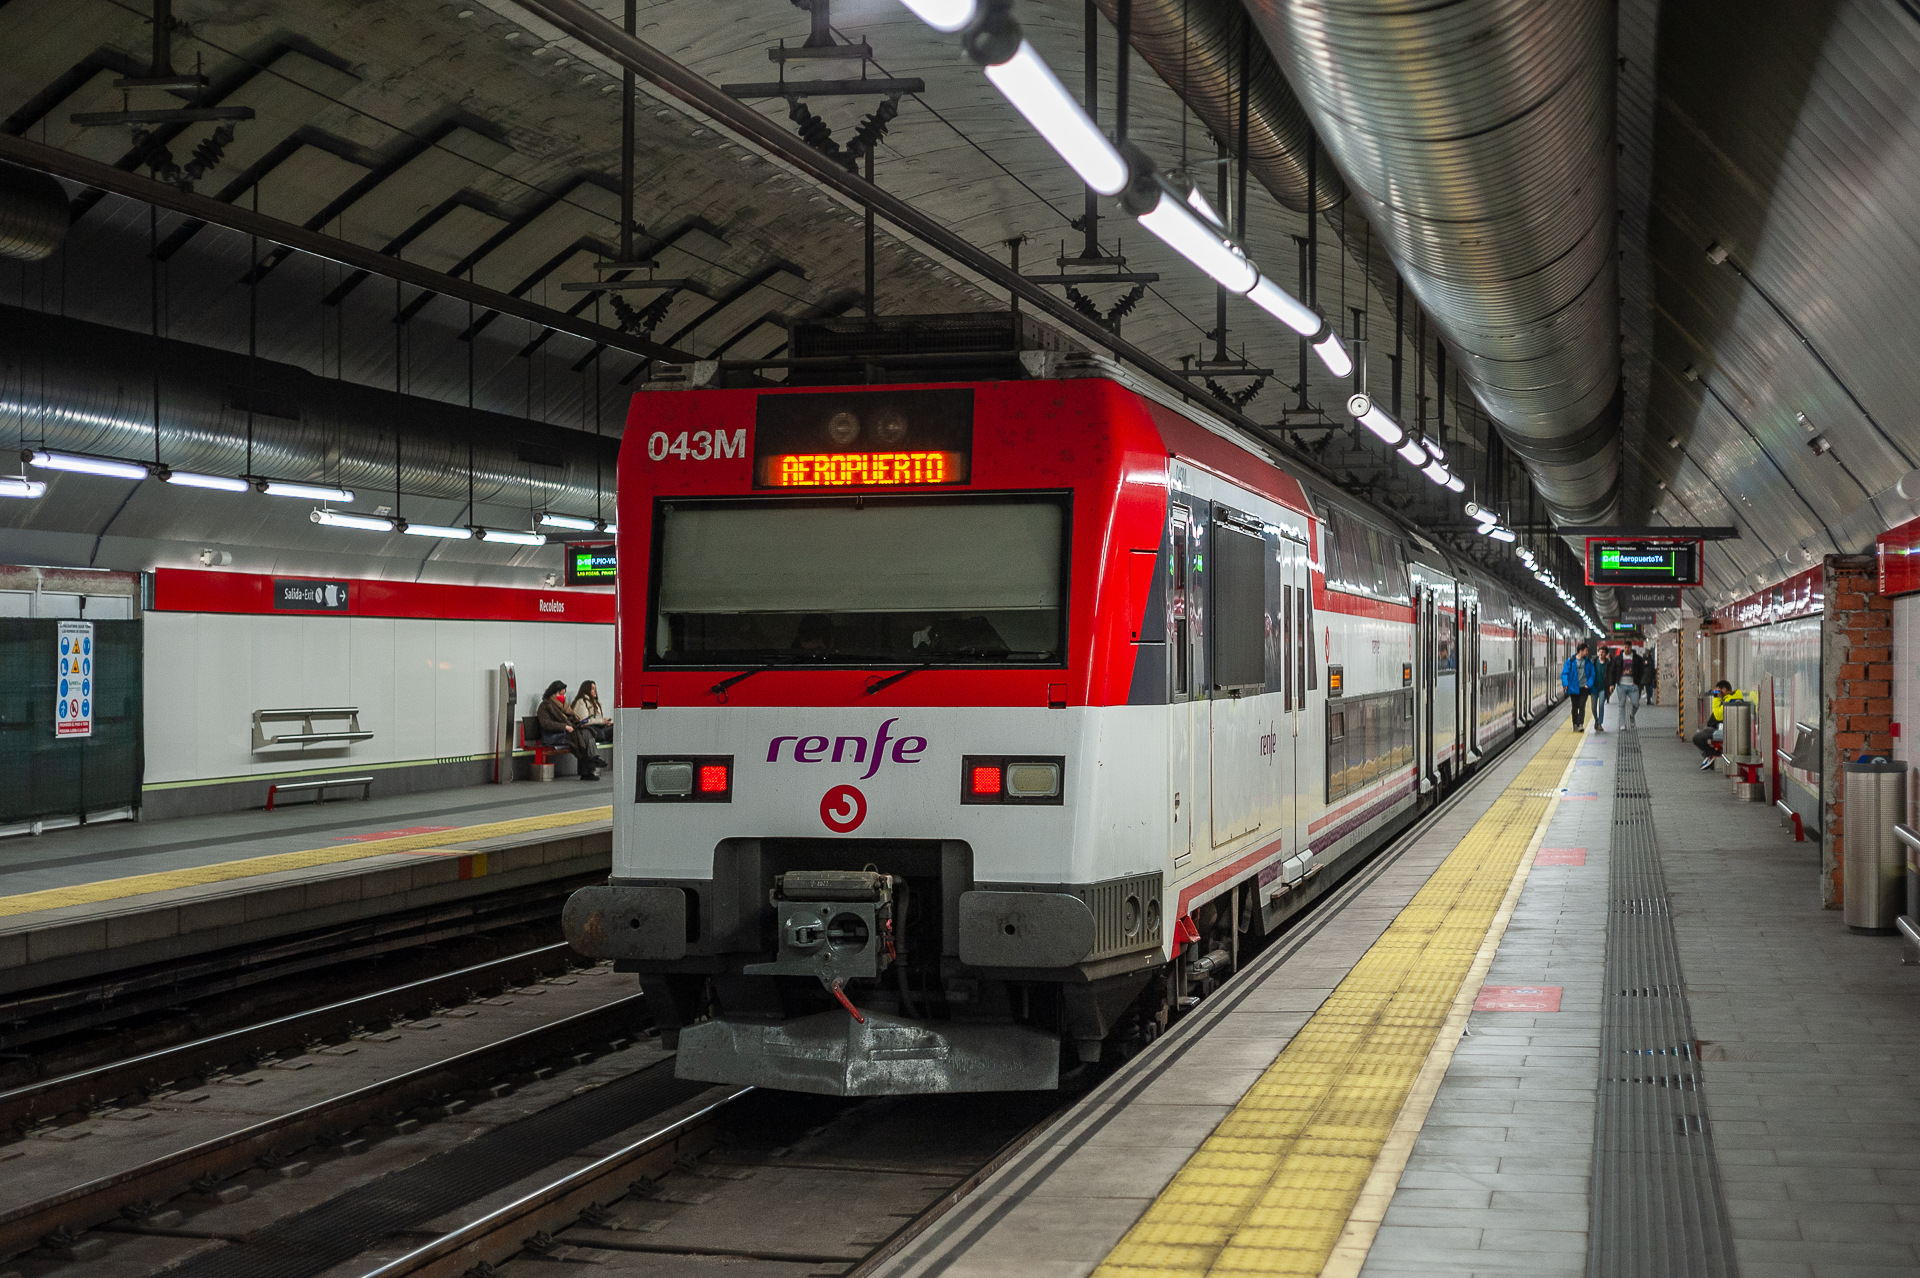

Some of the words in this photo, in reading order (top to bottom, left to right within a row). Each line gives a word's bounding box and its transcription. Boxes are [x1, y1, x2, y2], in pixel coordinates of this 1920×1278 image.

[648, 429, 746, 461] 043M
[783, 454, 943, 486] AEROPUERTO
[539, 598, 565, 613] Recoletos
[766, 717, 928, 780] renfe
[1260, 720, 1277, 766] renfe
